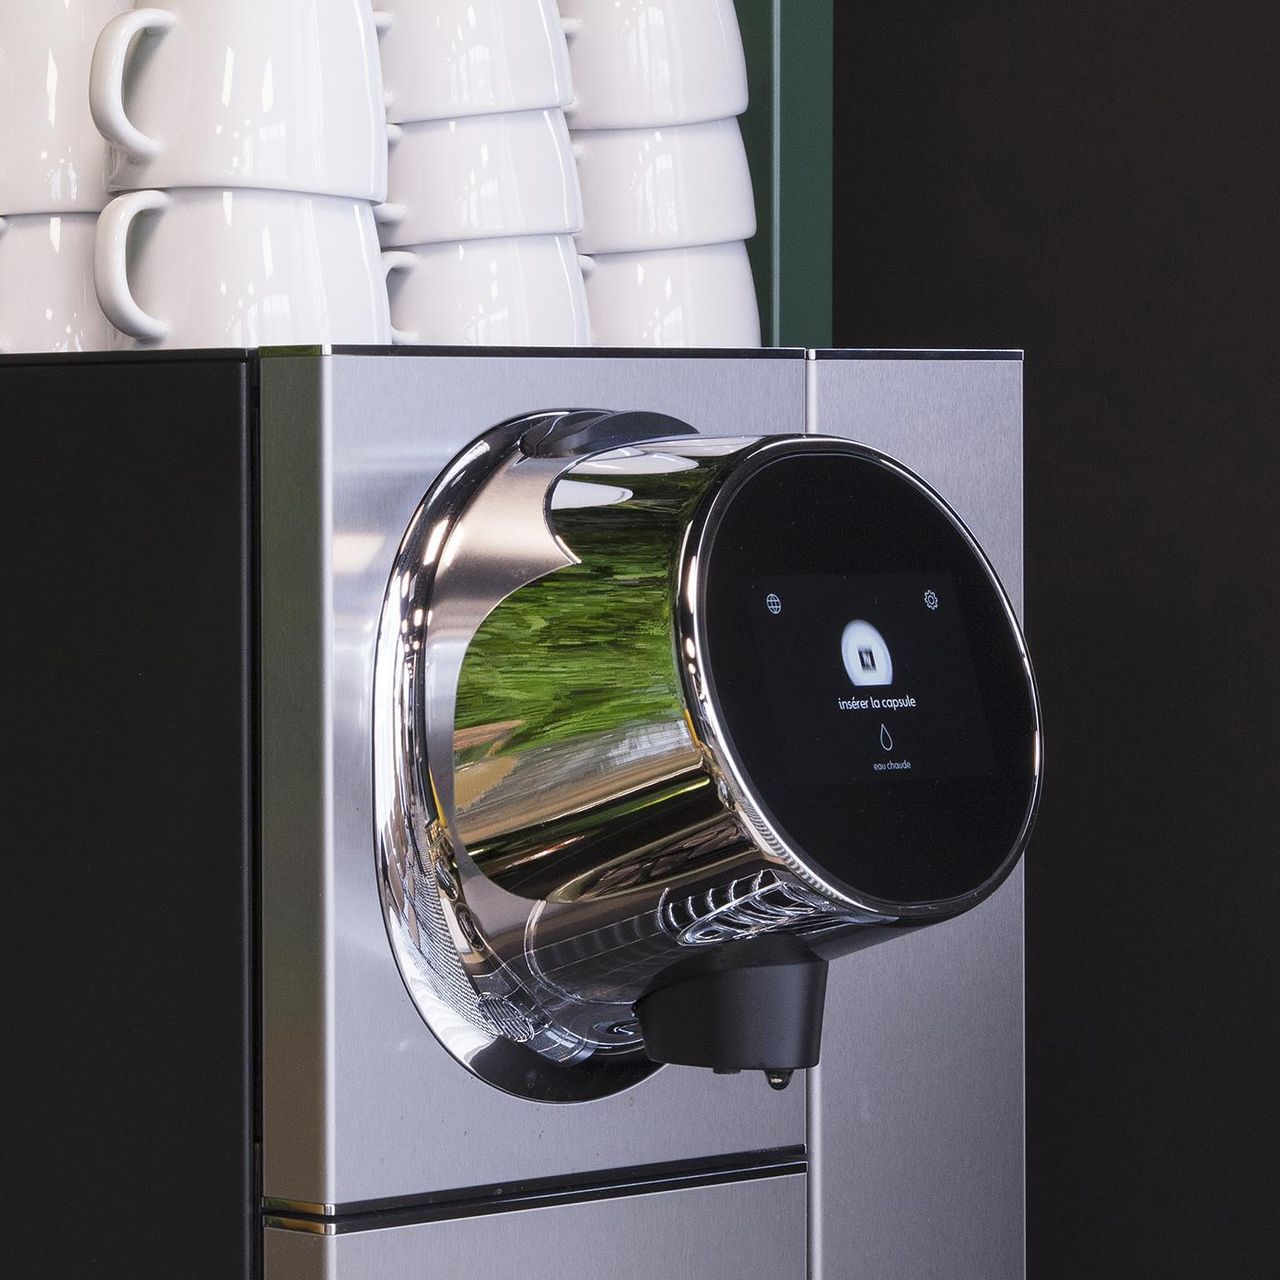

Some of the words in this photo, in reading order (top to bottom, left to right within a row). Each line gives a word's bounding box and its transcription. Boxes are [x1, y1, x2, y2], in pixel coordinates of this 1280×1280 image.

[838, 696, 869, 710] insérer
[870, 696, 880, 709] la
[881, 694, 917, 711] capsule
[873, 763, 886, 771] eau
[886, 760, 912, 770] chaude
